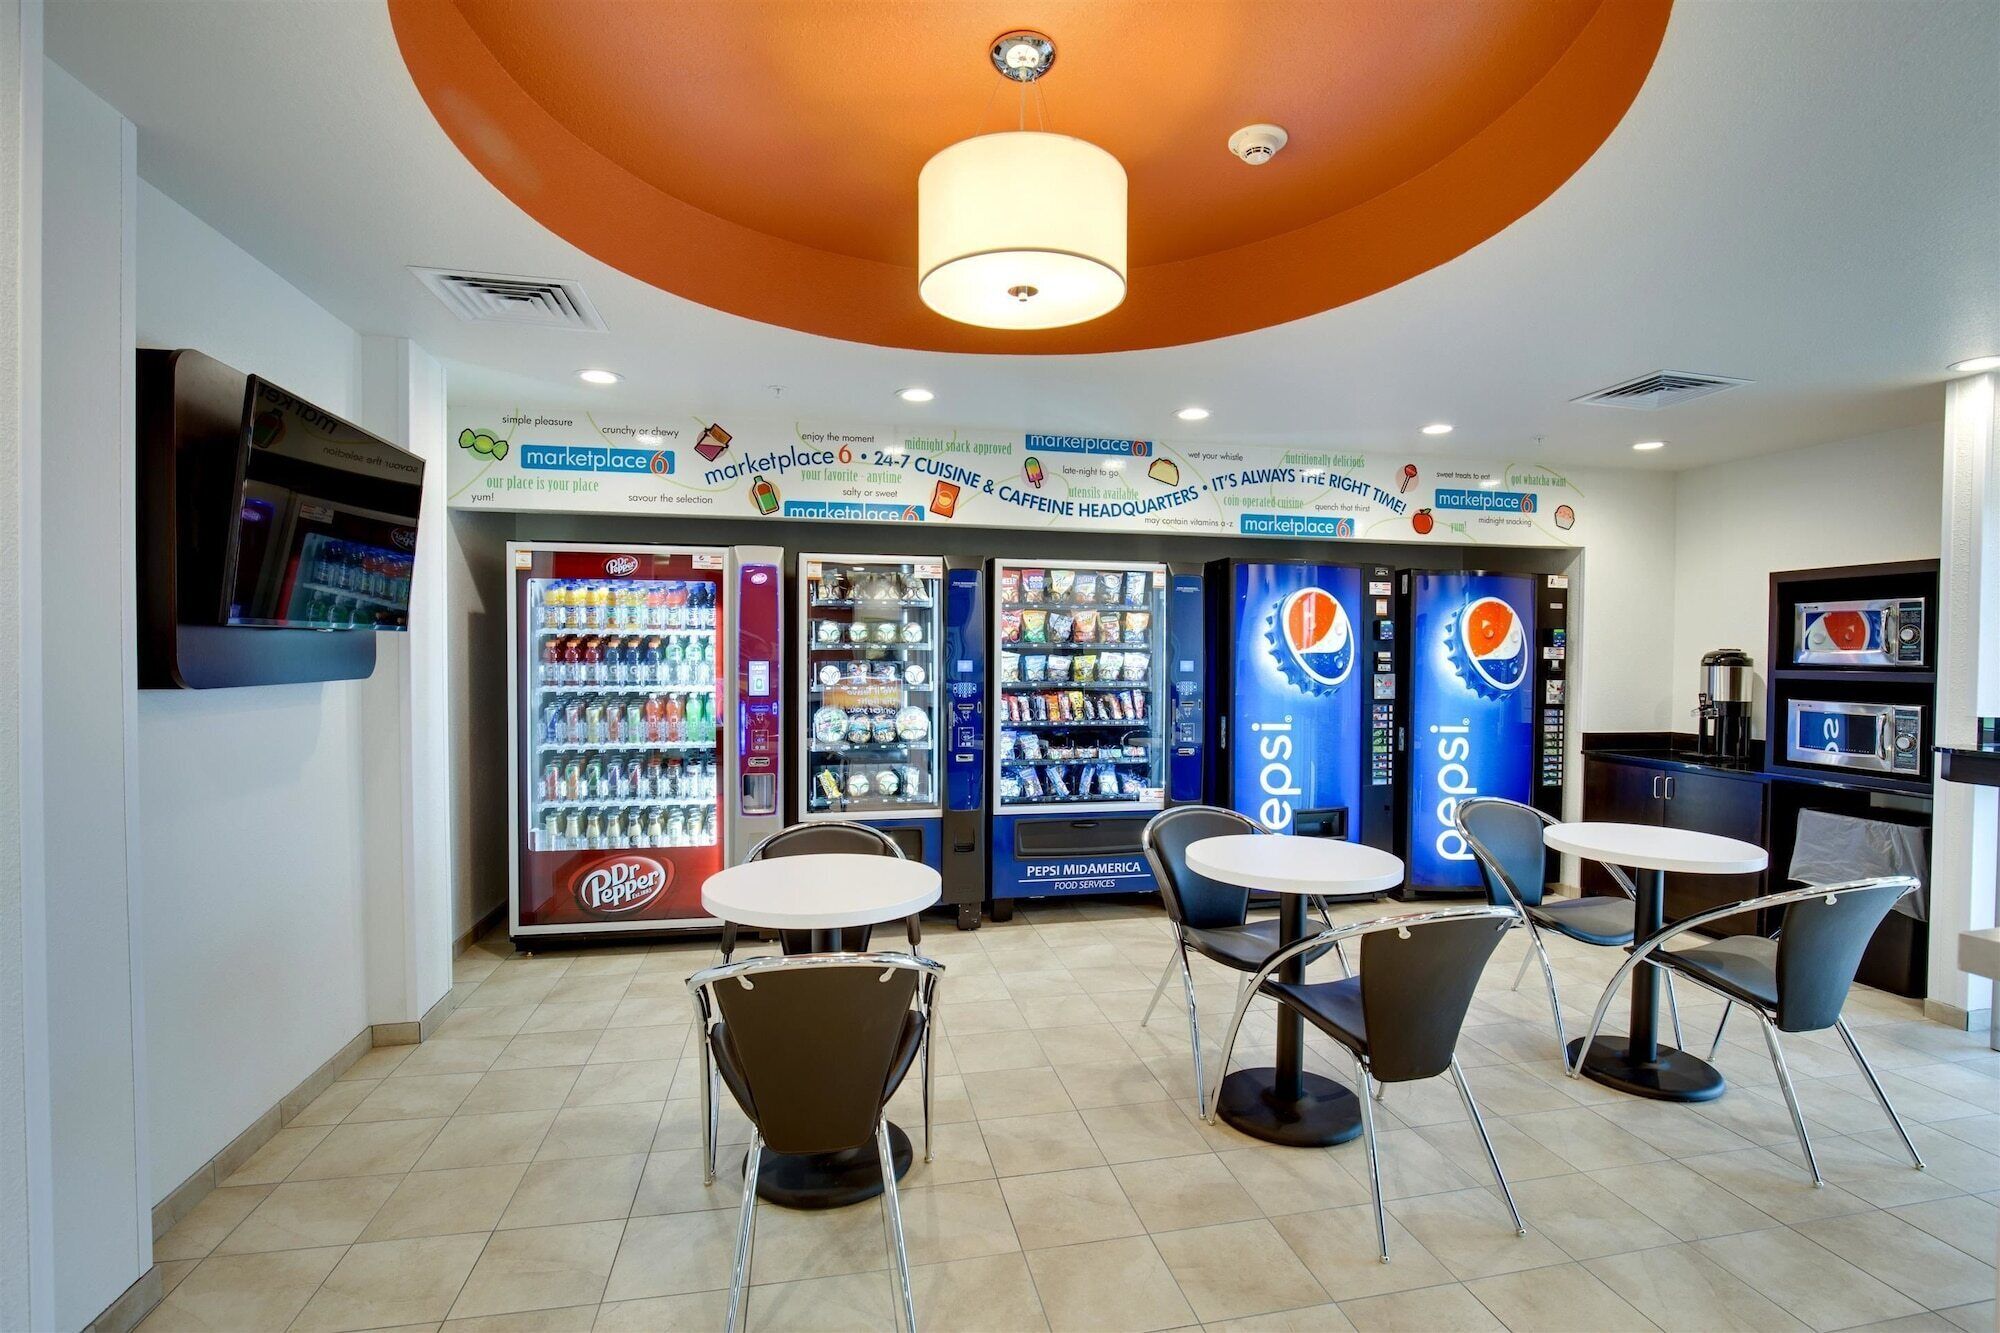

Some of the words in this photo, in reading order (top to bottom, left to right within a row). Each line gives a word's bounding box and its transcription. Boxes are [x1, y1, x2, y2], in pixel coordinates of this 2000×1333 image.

[502, 415, 532, 426] simple
[534, 416, 573, 427] pleasure
[602, 425, 636, 437] crunchy
[639, 428, 648, 436] or
[651, 426, 680, 438] chewy
[801, 432, 824, 442] enjoy
[827, 432, 839, 441] the
[842, 434, 875, 443] moment
[904, 437, 943, 451] midnight
[945, 440, 971, 453] snack
[973, 442, 1012, 456] approved
[1030, 434, 1130, 454] marketplace
[527, 446, 647, 472] marketplace
[1188, 451, 1201, 459] wet
[1202, 452, 1218, 461] your
[1219, 452, 1243, 461] whistle
[1285, 452, 1331, 467] nutritionally
[1332, 453, 1365, 468] delicious
[801, 470, 821, 481] your
[824, 468, 859, 482] favorite
[866, 470, 902, 484] anytime
[1062, 465, 1098, 477] late-night
[1100, 468, 1107, 476] to
[1108, 470, 1119, 478] go
[1436, 471, 1454, 479] sweet
[1473, 472, 1480, 480] to
[486, 477, 504, 489] our
[507, 475, 534, 491] place
[536, 477, 545, 490] is
[548, 479, 569, 492] your
[572, 477, 599, 493] place
[705, 445, 834, 485] marketplace
[838, 443, 852, 464] 6
[874, 450, 911, 469] 24-7
[914, 457, 982, 488] CUISINE
[983, 479, 995, 495] &
[998, 486, 1074, 516] CAFFEINE
[1078, 485, 1199, 518] HEADQUARTERS
[1211, 473, 1238, 491] IT'S
[1241, 468, 1296, 486] ALWAYS
[1329, 474, 1371, 497] RIGHT
[1373, 487, 1407, 516] TIME!
[1510, 475, 1523, 487] got
[1524, 474, 1550, 487] whatcha
[1551, 475, 1567, 488] want
[471, 493, 495, 503] yum!
[628, 495, 657, 503] savour
[660, 493, 674, 503] the
[676, 494, 713, 504] selection
[842, 487, 862, 498] salty
[864, 489, 873, 497] or
[875, 489, 898, 498] sweet
[1068, 487, 1100, 499] utensils
[1102, 488, 1139, 500] available
[1277, 496, 1303, 509] cuisine
[1315, 502, 1339, 512] quench
[1340, 502, 1353, 511] that
[1354, 503, 1370, 512] thirst
[1439, 490, 1519, 511] marketplace
[790, 501, 899, 520] marketplace
[1190, 519, 1219, 527] vitamins
[1245, 515, 1334, 536] marketplace
[1451, 521, 1467, 533] yum!
[1478, 516, 1505, 526] midnight
[1505, 517, 1532, 528] snacking
[606, 559, 636, 575] Pepper
[1251, 722, 1302, 836] epsi
[1429, 724, 1478, 861] pepsi
[611, 863, 640, 886] Dr
[1027, 865, 1060, 877] PEPSI
[1063, 862, 1141, 876] MIDAMERICA
[581, 869, 659, 909] Pepper
[1054, 881, 1078, 890] FOOD
[1079, 879, 1116, 889] SERVICES
